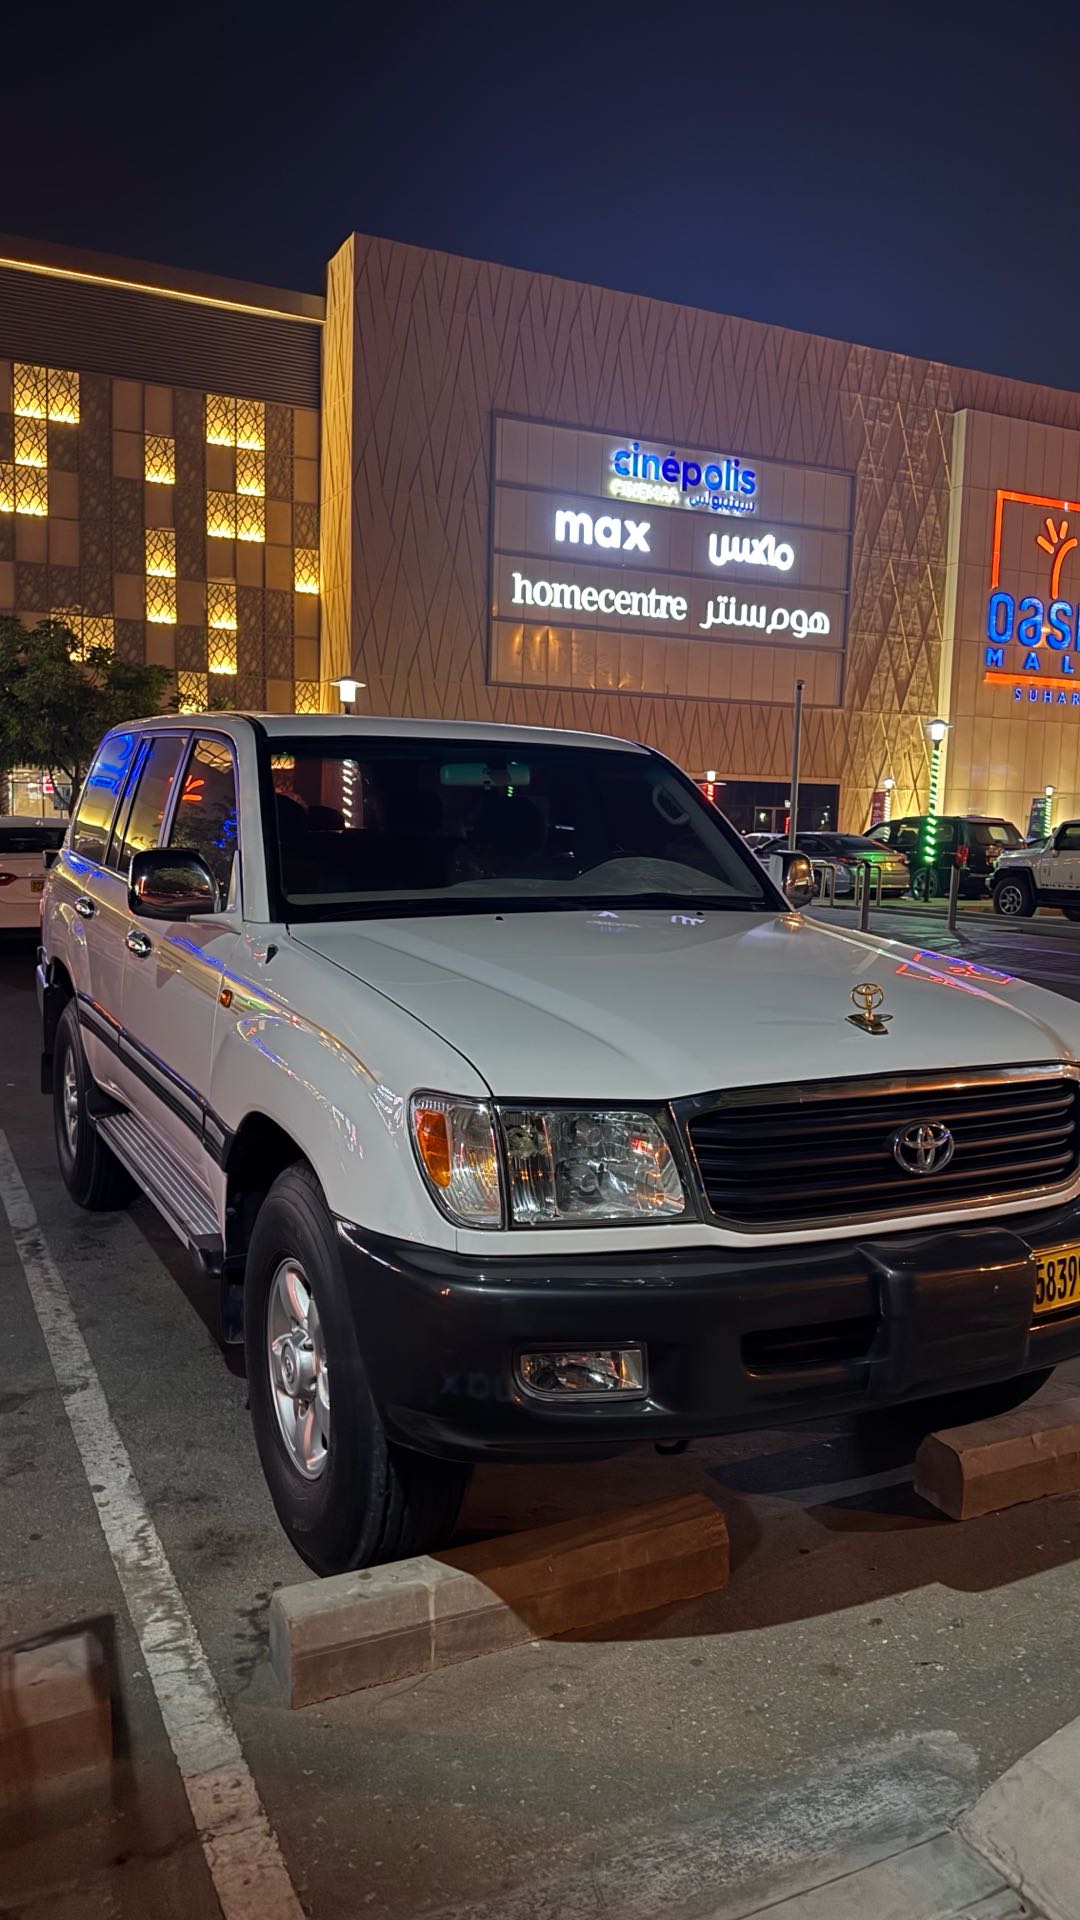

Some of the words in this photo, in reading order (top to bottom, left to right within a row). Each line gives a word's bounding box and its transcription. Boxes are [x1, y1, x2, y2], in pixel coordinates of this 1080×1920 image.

[612, 442, 757, 494] cinépolis
[554, 510, 652, 553] max
[511, 573, 688, 622] homecentre
[1035, 1254, 1080, 1305] 5839
